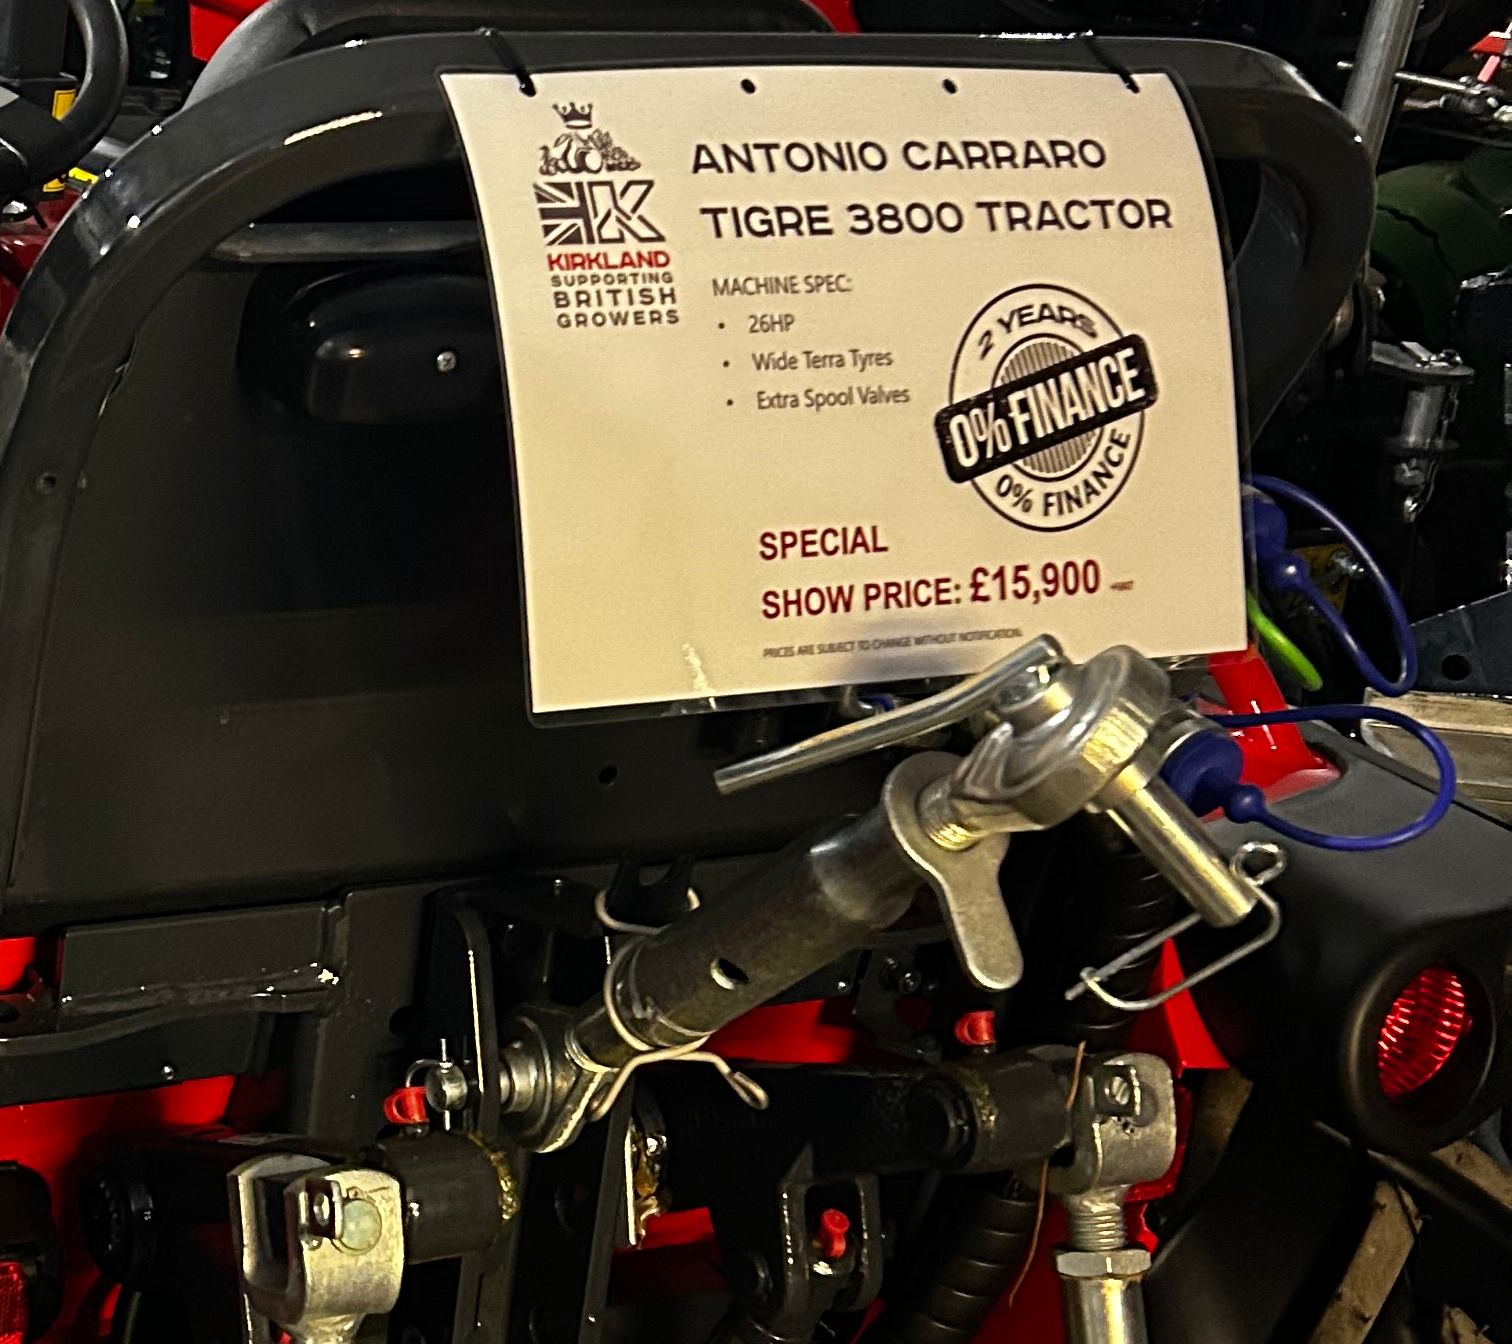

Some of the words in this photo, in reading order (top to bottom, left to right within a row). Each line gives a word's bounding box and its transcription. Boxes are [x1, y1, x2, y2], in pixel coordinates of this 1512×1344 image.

[691, 140, 888, 174] ANTONIO
[901, 138, 1107, 171] CARRARO
[699, 204, 834, 239] TIGRE
[846, 201, 964, 236] 3800
[974, 198, 1174, 232] TRACTOR
[546, 250, 671, 272] KIRKLAND
[550, 271, 674, 288] SUPPORTING
[712, 275, 799, 297] MACHINE
[803, 273, 853, 295] SPEC:
[553, 286, 677, 309] BRITISH
[556, 309, 680, 329] GROWERS
[748, 313, 796, 334] 26HP
[977, 329, 996, 361] 2
[996, 302, 1098, 339] YEARS
[752, 351, 799, 371] Wide
[802, 350, 846, 370] Terra
[848, 348, 894, 373] Tyres
[756, 390, 800, 410] Extra
[803, 385, 854, 412] Spool
[856, 384, 911, 405] Valves
[948, 401, 1013, 468] 0%
[1007, 347, 1147, 446] FINANCE
[995, 473, 1034, 514] 0%
[1042, 427, 1132, 517] FINANCE
[759, 525, 890, 561] SPECIAL
[761, 584, 855, 620] SHOW
[863, 577, 962, 612] PRICE:
[969, 559, 1101, 605] £15,900
